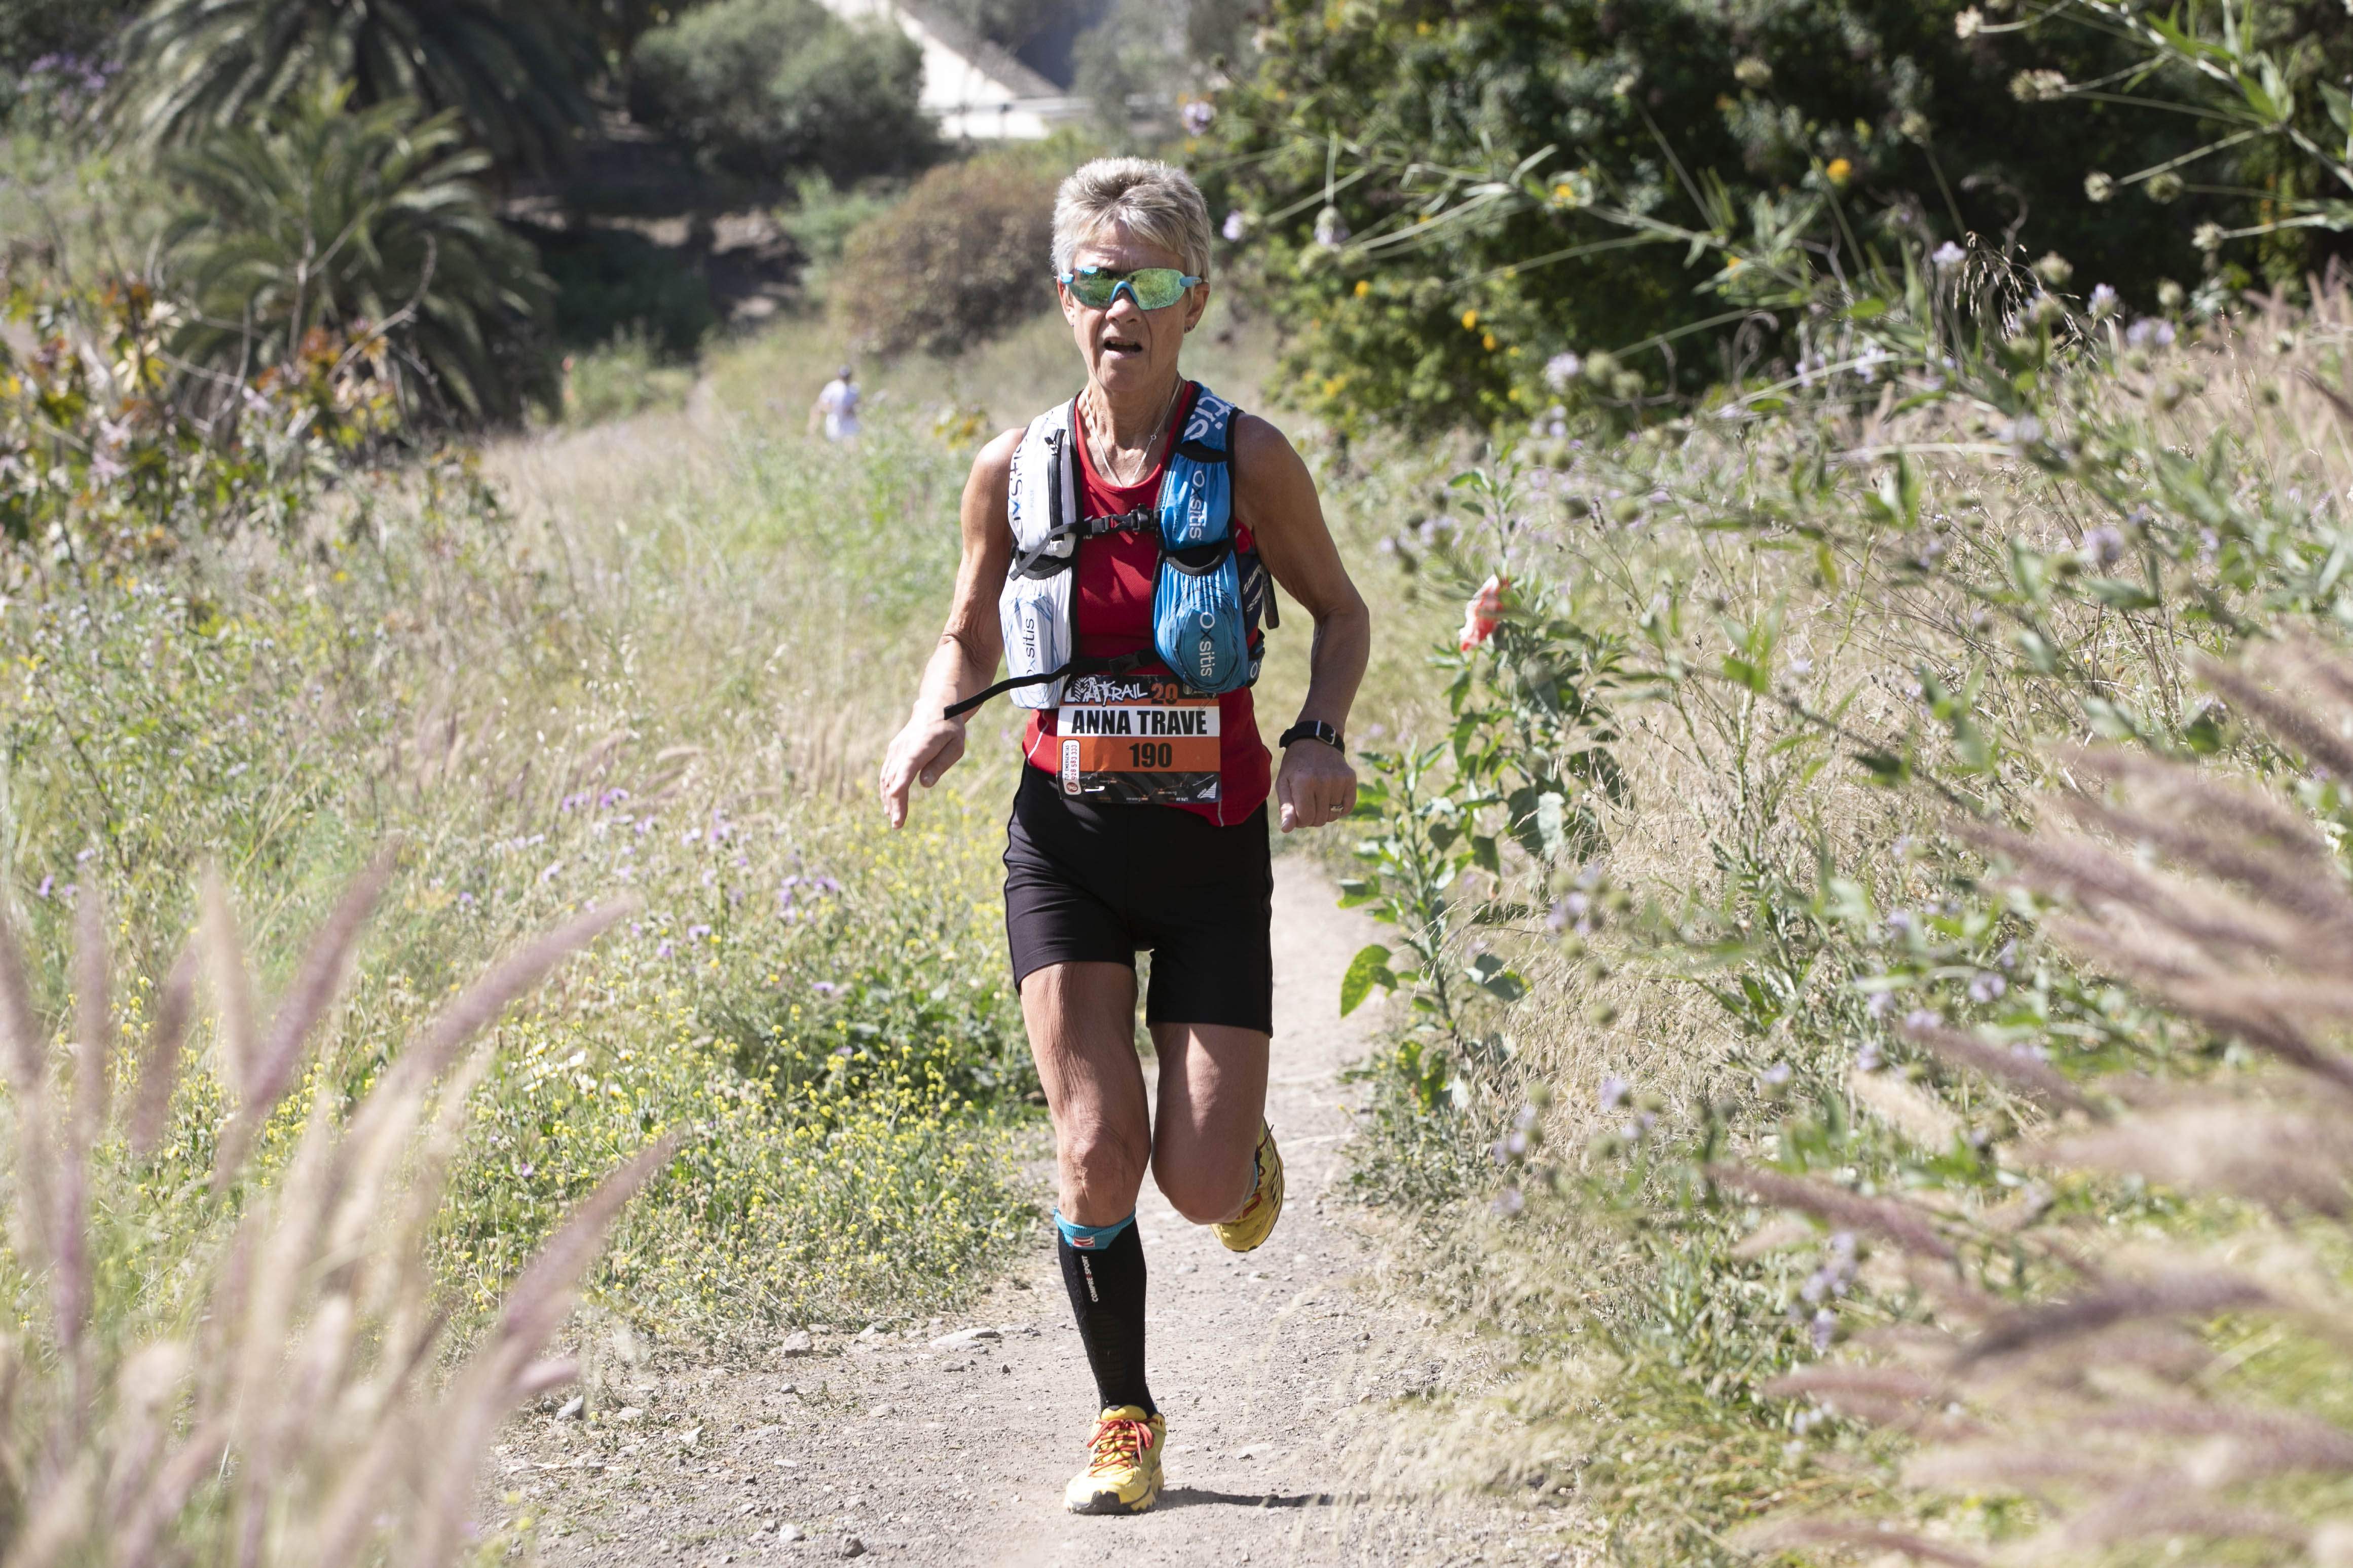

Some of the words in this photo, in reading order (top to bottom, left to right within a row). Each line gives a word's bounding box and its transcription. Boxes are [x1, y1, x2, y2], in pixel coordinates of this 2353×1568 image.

[1200, 612, 1215, 677] Oxsitis
[1071, 710, 1131, 734] ANNA
[1137, 710, 1207, 734] TRAVE
[1129, 743, 1172, 768] 190
